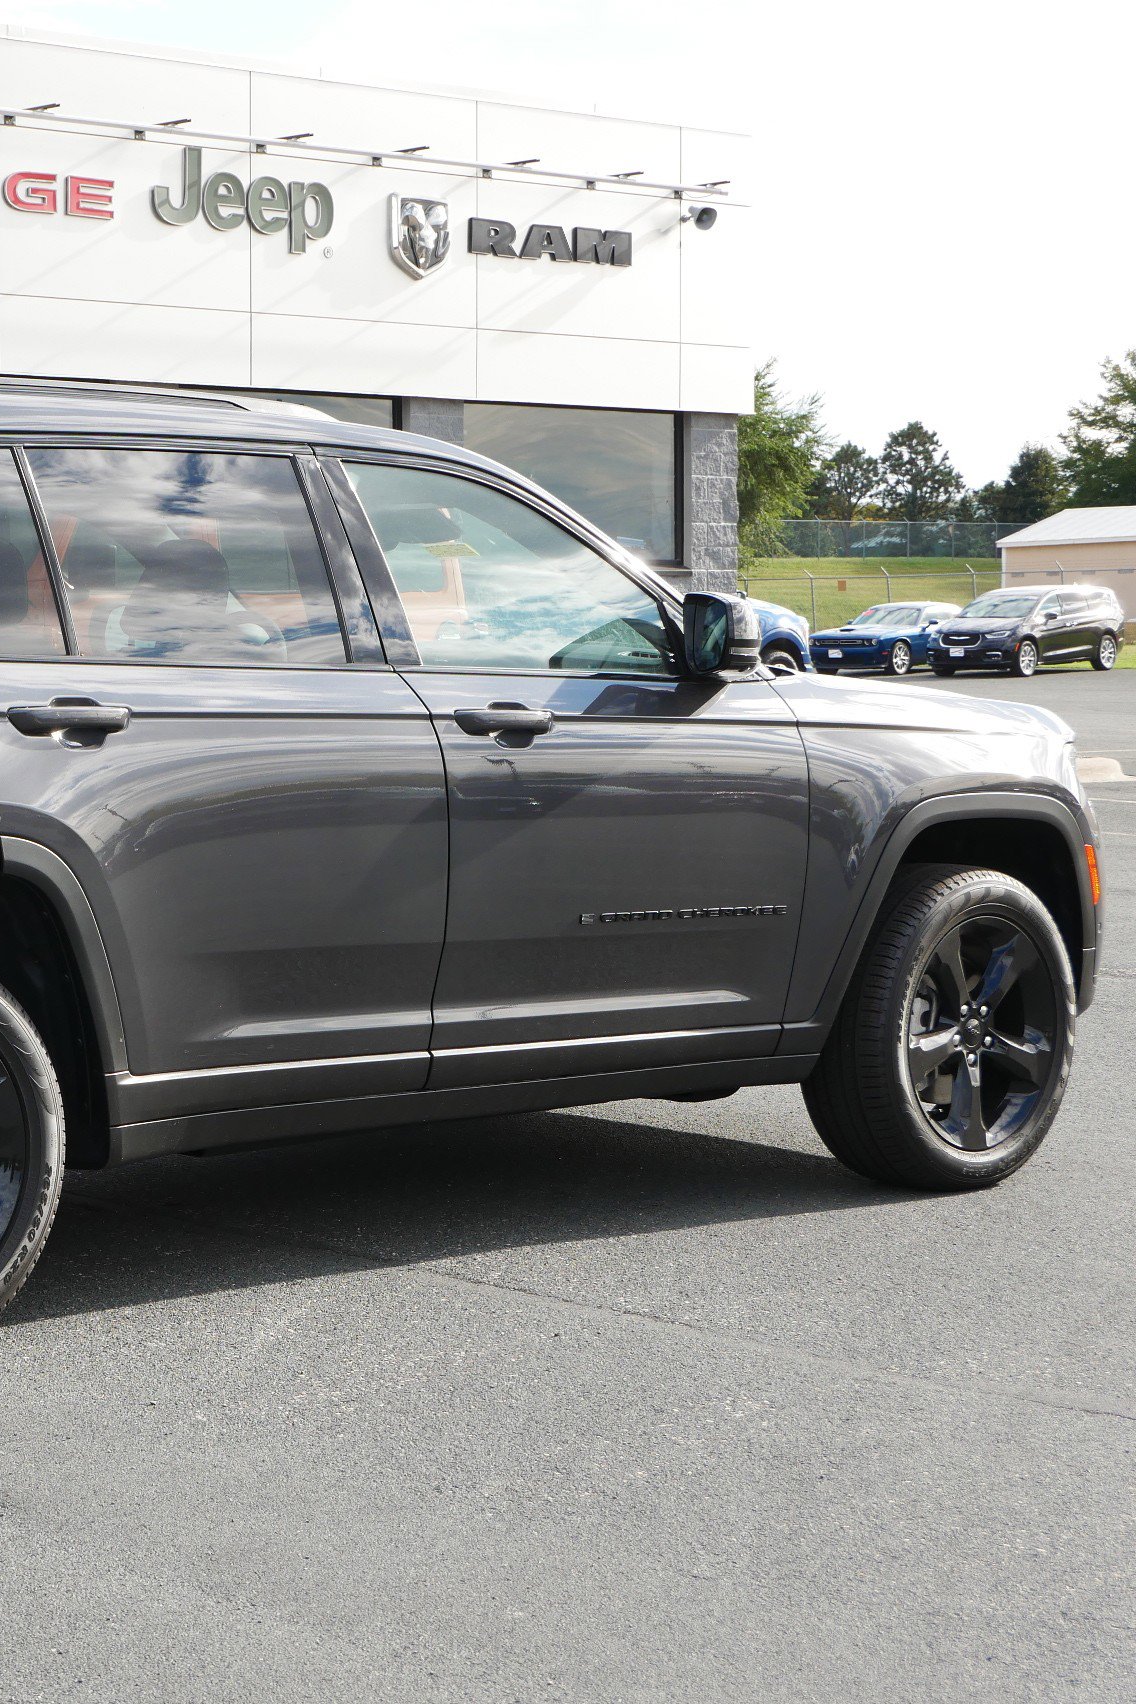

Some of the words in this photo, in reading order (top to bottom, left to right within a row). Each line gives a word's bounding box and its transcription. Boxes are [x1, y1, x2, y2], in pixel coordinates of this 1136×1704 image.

[151, 146, 335, 254] Jeep
[467, 216, 634, 267] RAM
[599, 909, 674, 923] GRAND
[677, 905, 788, 919] CHEROKEE
